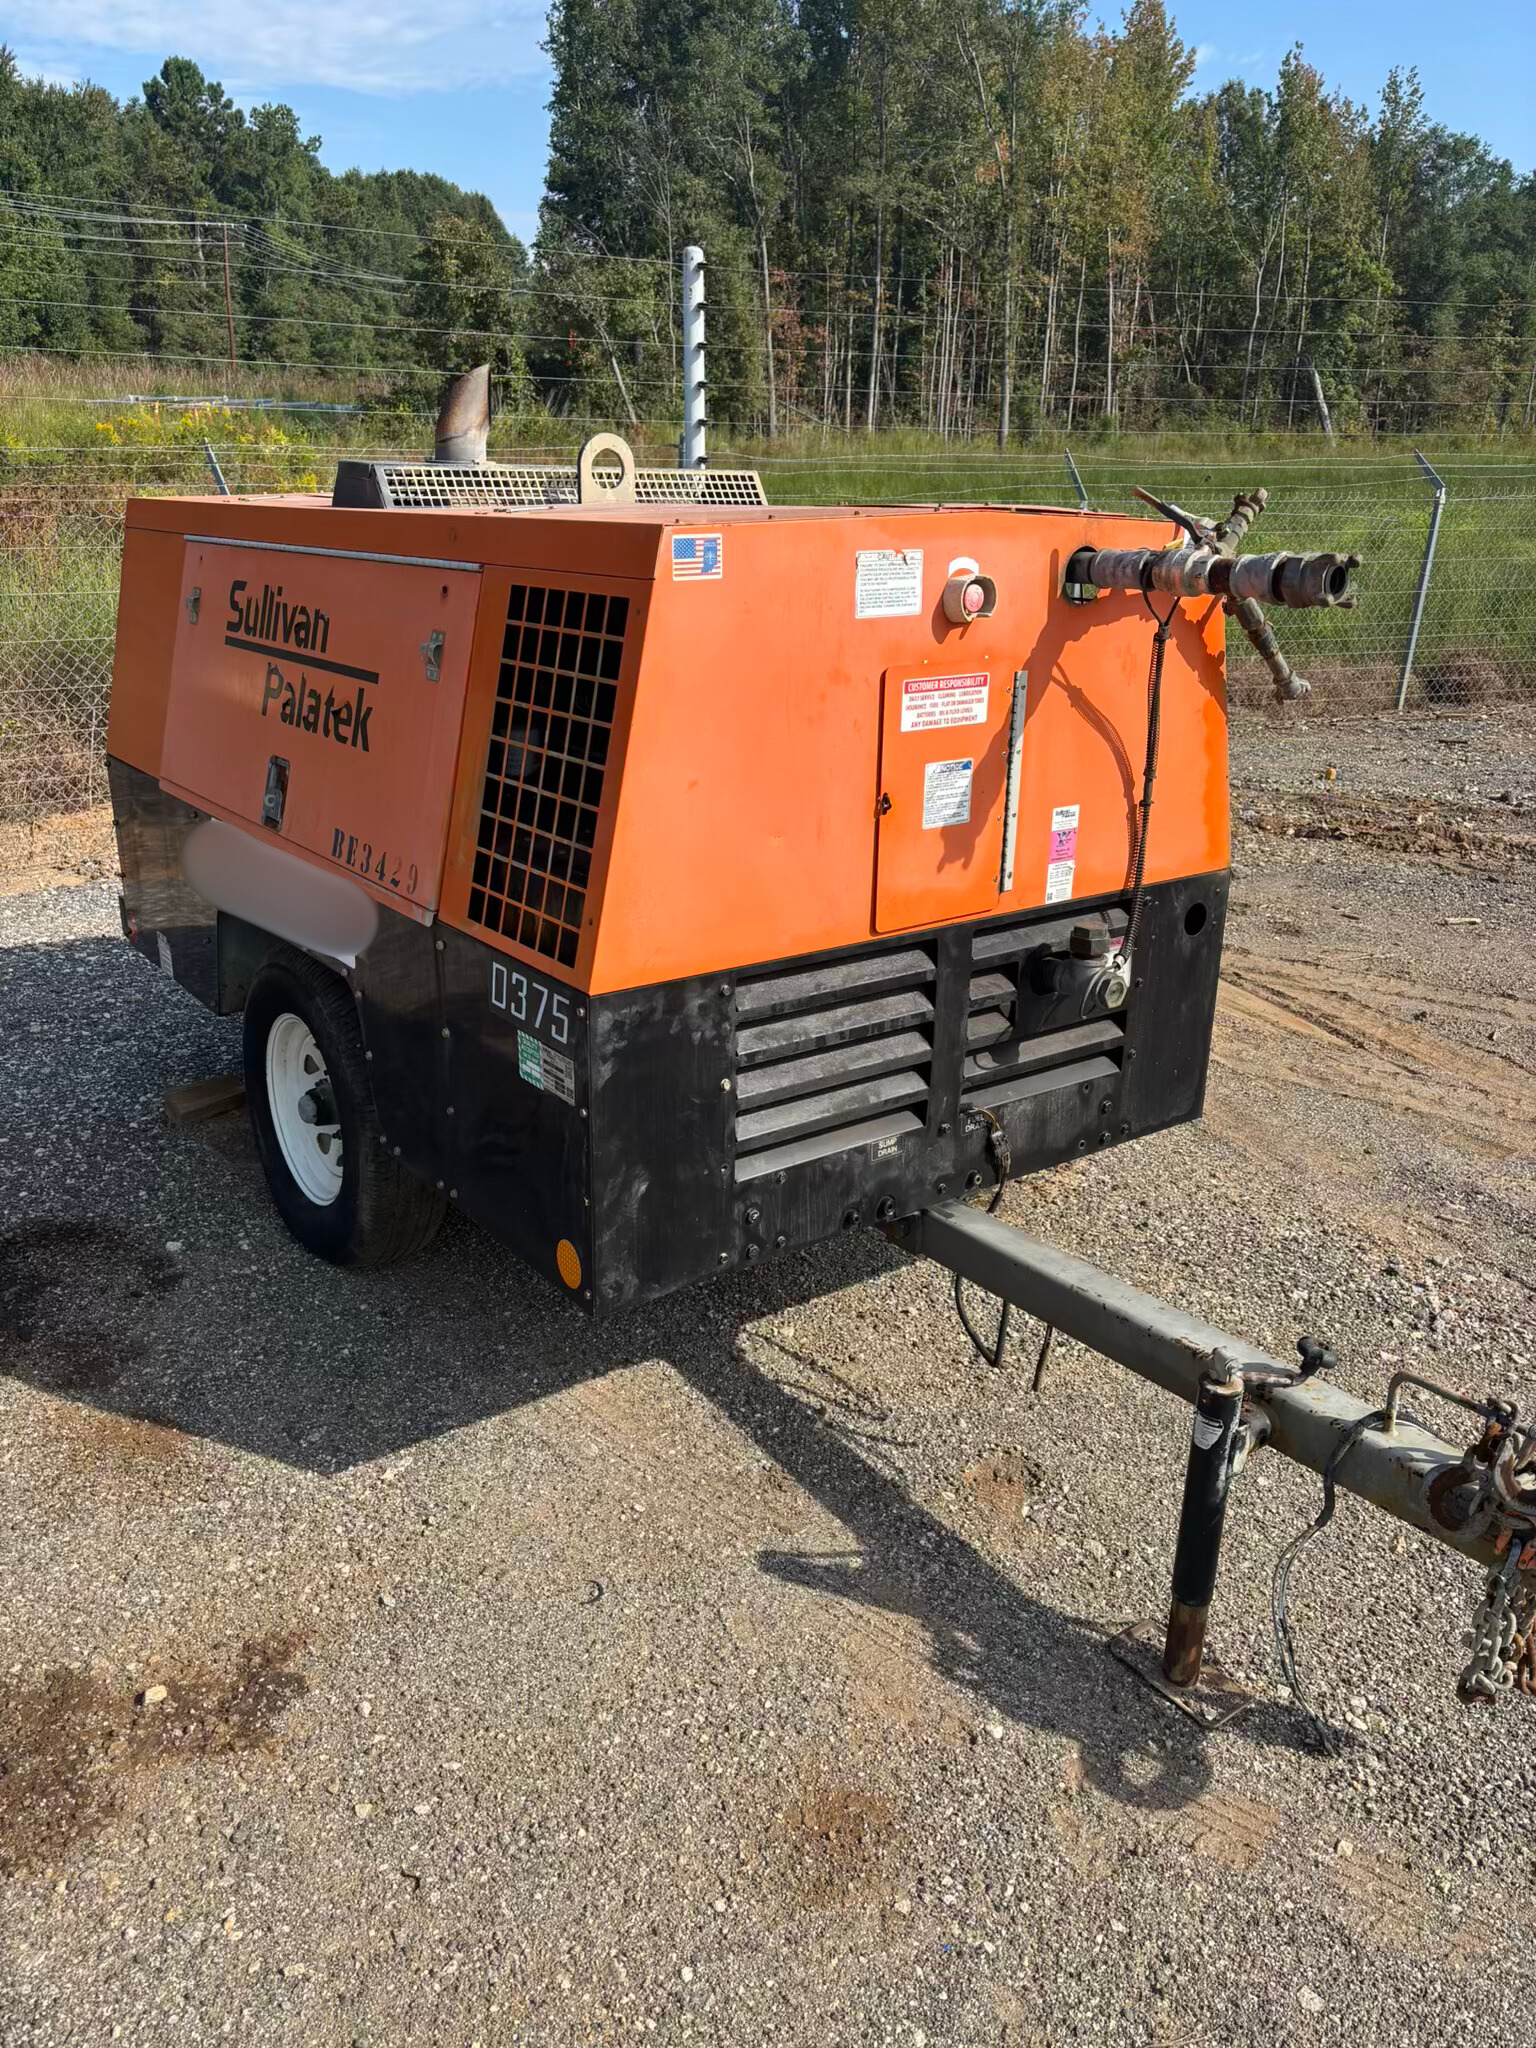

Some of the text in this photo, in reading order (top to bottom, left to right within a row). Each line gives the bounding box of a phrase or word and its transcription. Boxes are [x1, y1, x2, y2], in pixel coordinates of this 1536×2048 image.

[226, 580, 330, 653] Sullivan
[908, 676, 984, 691] CUSTOMER RESPONSIBILITY
[261, 662, 373, 752] Palatek
[922, 719, 942, 727] DAMAGE
[951, 715, 978, 724] EQUIPMENT
[331, 828, 419, 895] BE3429
[968, 1114, 985, 1124] FUEL
[878, 1137, 898, 1148] SUMP
[878, 1145, 898, 1158] DRAIN
